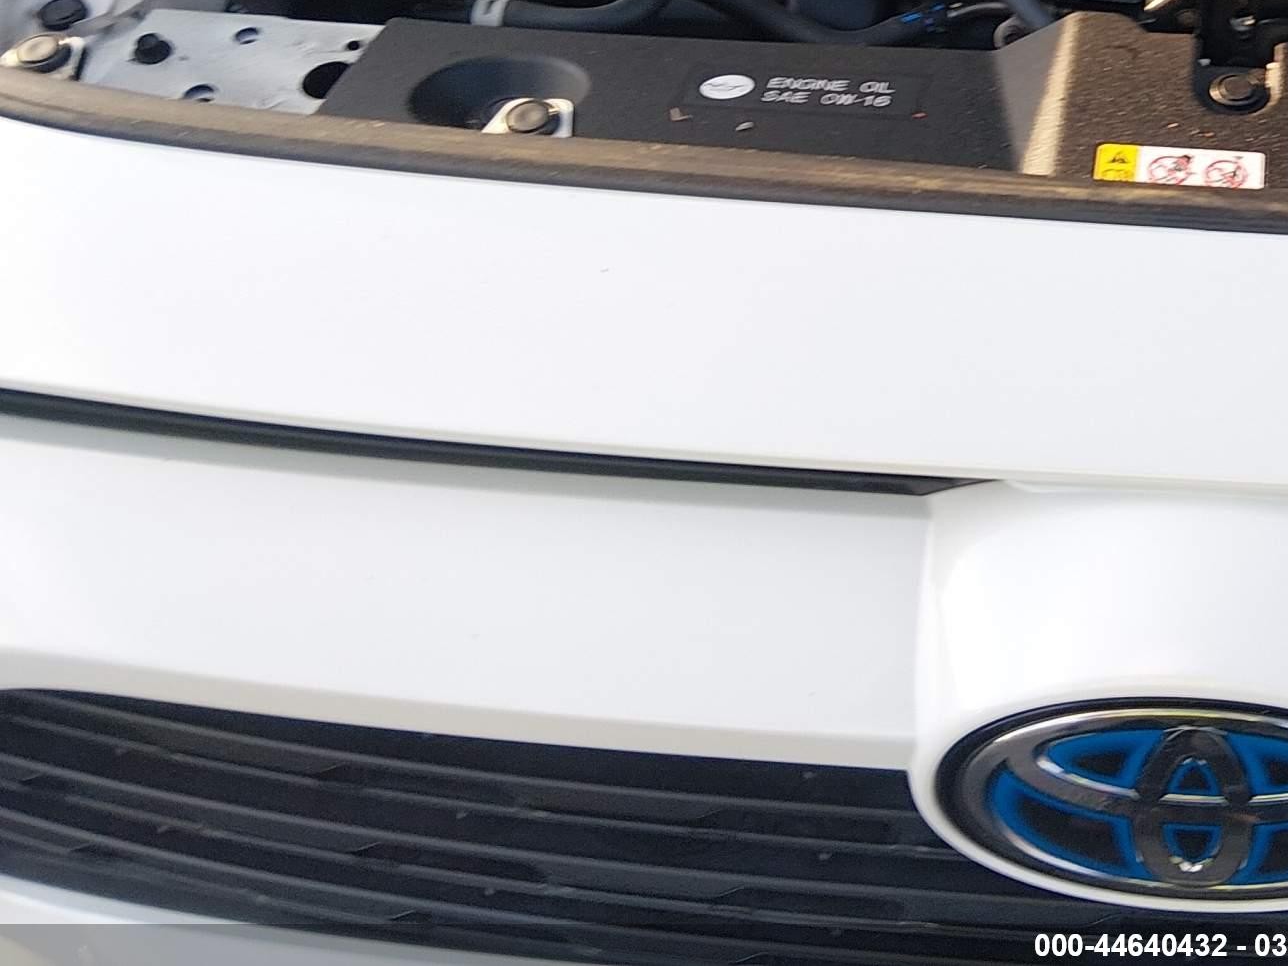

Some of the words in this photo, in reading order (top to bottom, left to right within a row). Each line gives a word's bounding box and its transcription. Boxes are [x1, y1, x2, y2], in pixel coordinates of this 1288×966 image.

[766, 77, 850, 91] ENGINE
[859, 81, 896, 93] OIL
[761, 90, 809, 103] SAE
